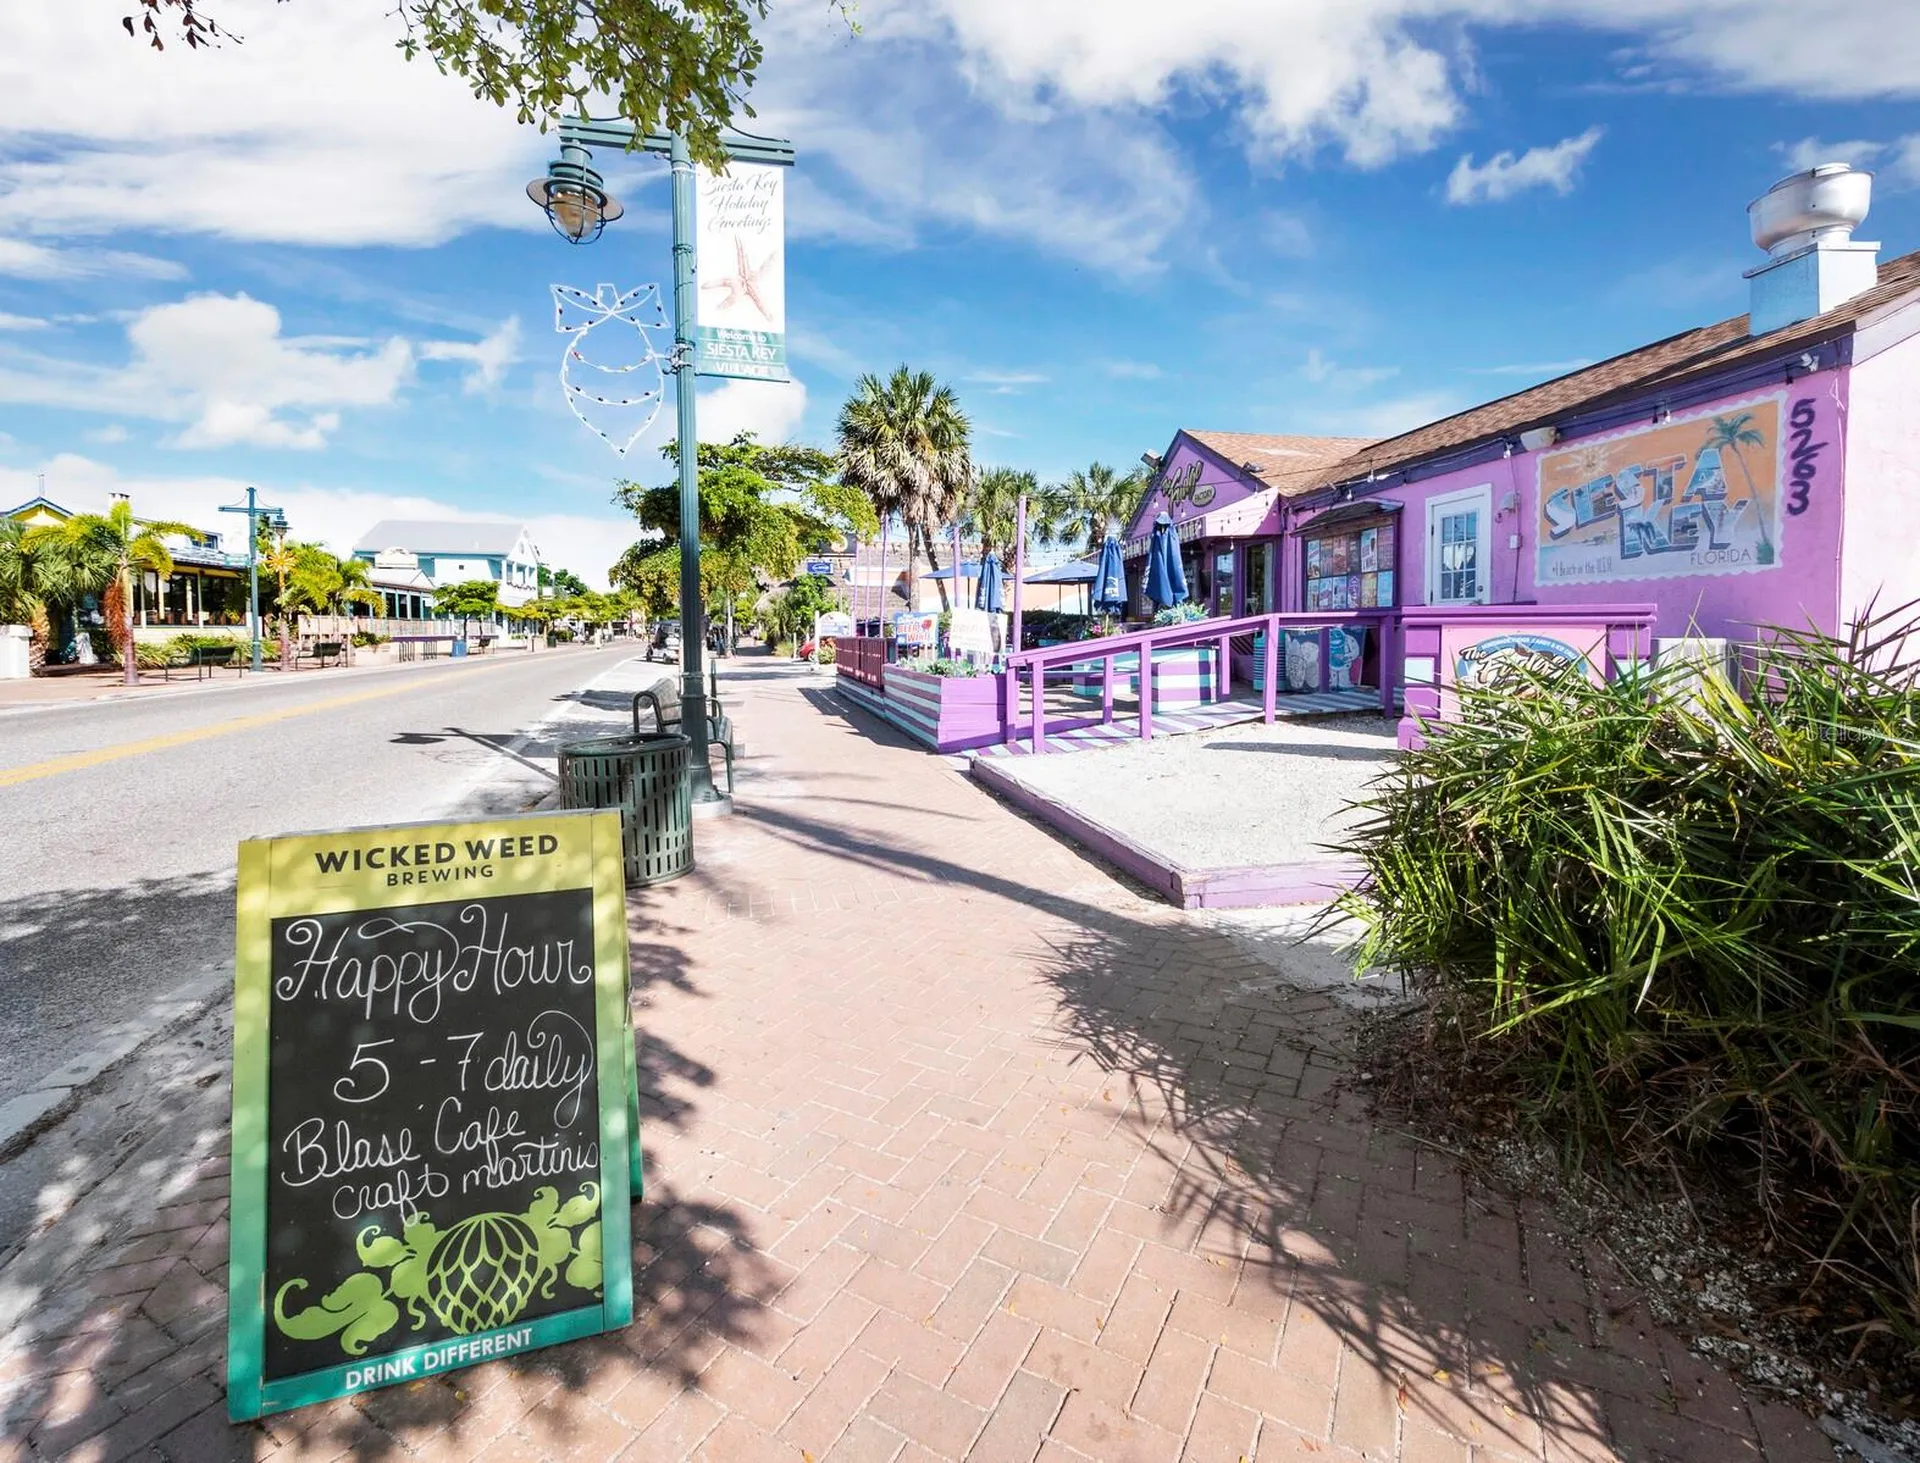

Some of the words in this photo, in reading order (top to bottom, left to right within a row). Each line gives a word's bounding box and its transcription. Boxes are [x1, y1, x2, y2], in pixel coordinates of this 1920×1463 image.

[701, 177, 744, 196] Siesta
[746, 171, 778, 196] Key
[709, 195, 768, 215] Holiday
[707, 343, 749, 359] SIESTA
[752, 347, 777, 360] KEY
[1543, 448, 1728, 540] SIESTA
[1618, 499, 1749, 560] KEY
[1690, 548, 1752, 565] FLORIDA
[315, 843, 456, 874] WICKED
[465, 834, 560, 858] WEED
[386, 865, 494, 887] BREWING
[275, 916, 460, 1024] Happy
[453, 903, 592, 995] Hour
[333, 1038, 396, 1104] 5
[446, 1031, 485, 1092] 7
[484, 1009, 594, 1129] daily
[332, 1164, 450, 1226] craft
[461, 1131, 600, 1195] martinis
[345, 1356, 416, 1390] DRINK
[424, 1328, 534, 1371] DIFFERENT
